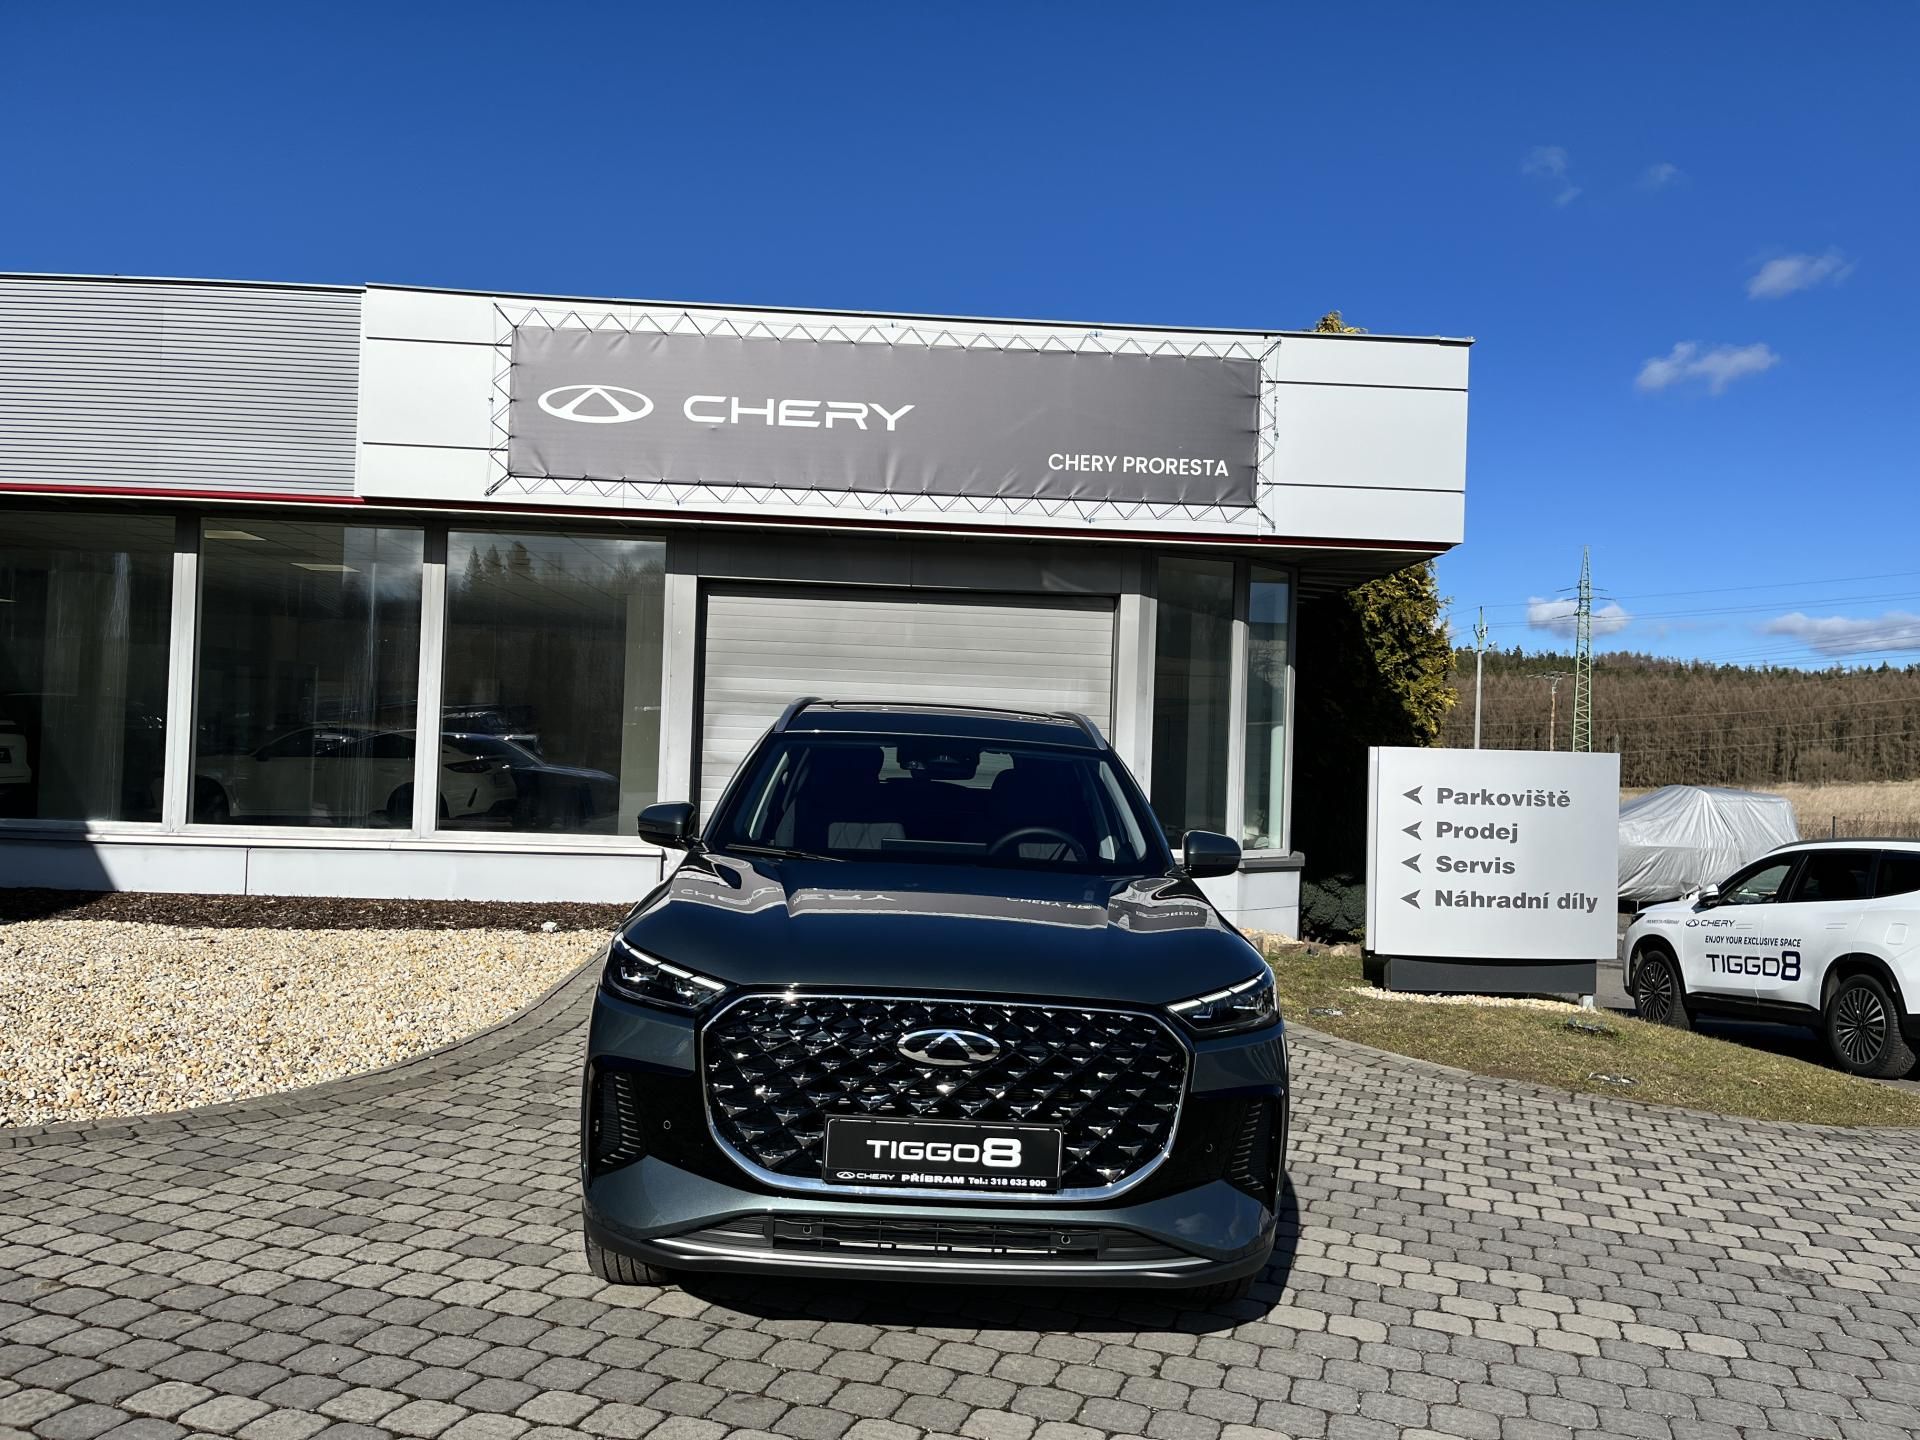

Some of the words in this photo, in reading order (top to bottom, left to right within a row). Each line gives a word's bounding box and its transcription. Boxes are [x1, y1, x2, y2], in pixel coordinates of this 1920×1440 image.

[683, 394, 916, 431] CHERY
[1048, 453, 1118, 473] CHERY
[1122, 456, 1229, 477] PRORESTA
[1436, 787, 1571, 808] Parkoviště
[1436, 821, 1518, 844] Prodej
[1435, 855, 1516, 875] Servis
[1435, 889, 1550, 909] Náhradní
[1556, 892, 1598, 914] díly
[1700, 919, 1736, 928] CHERY
[1705, 935, 1725, 944] ENJOY
[1726, 936, 1743, 945] YOUR
[1744, 936, 1779, 947] EXCLUSIVE
[1780, 938, 1802, 948] SPACE
[856, 1172, 896, 1181] CHERY
[901, 1172, 965, 1184] PŘÍBRAM
[990, 1177, 1009, 1186] 318
